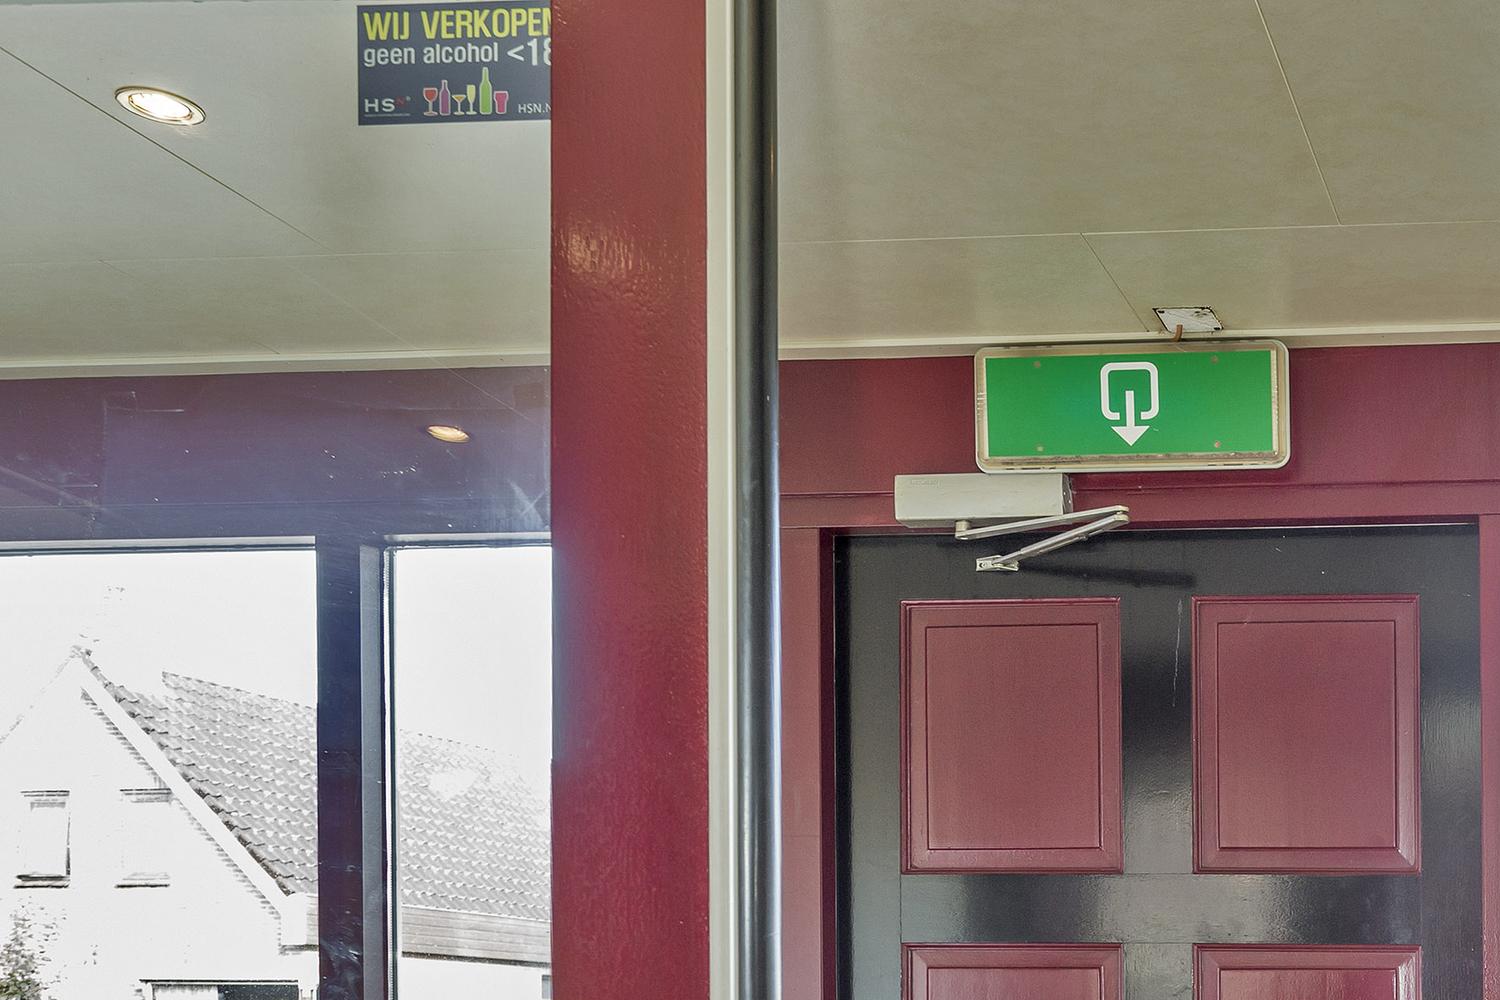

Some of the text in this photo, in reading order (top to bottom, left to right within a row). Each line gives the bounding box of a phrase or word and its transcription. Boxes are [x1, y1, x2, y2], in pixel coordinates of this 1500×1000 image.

[363, 11, 410, 41] WIJ
[364, 46, 416, 67] geen
[423, 42, 498, 64] alcohol
